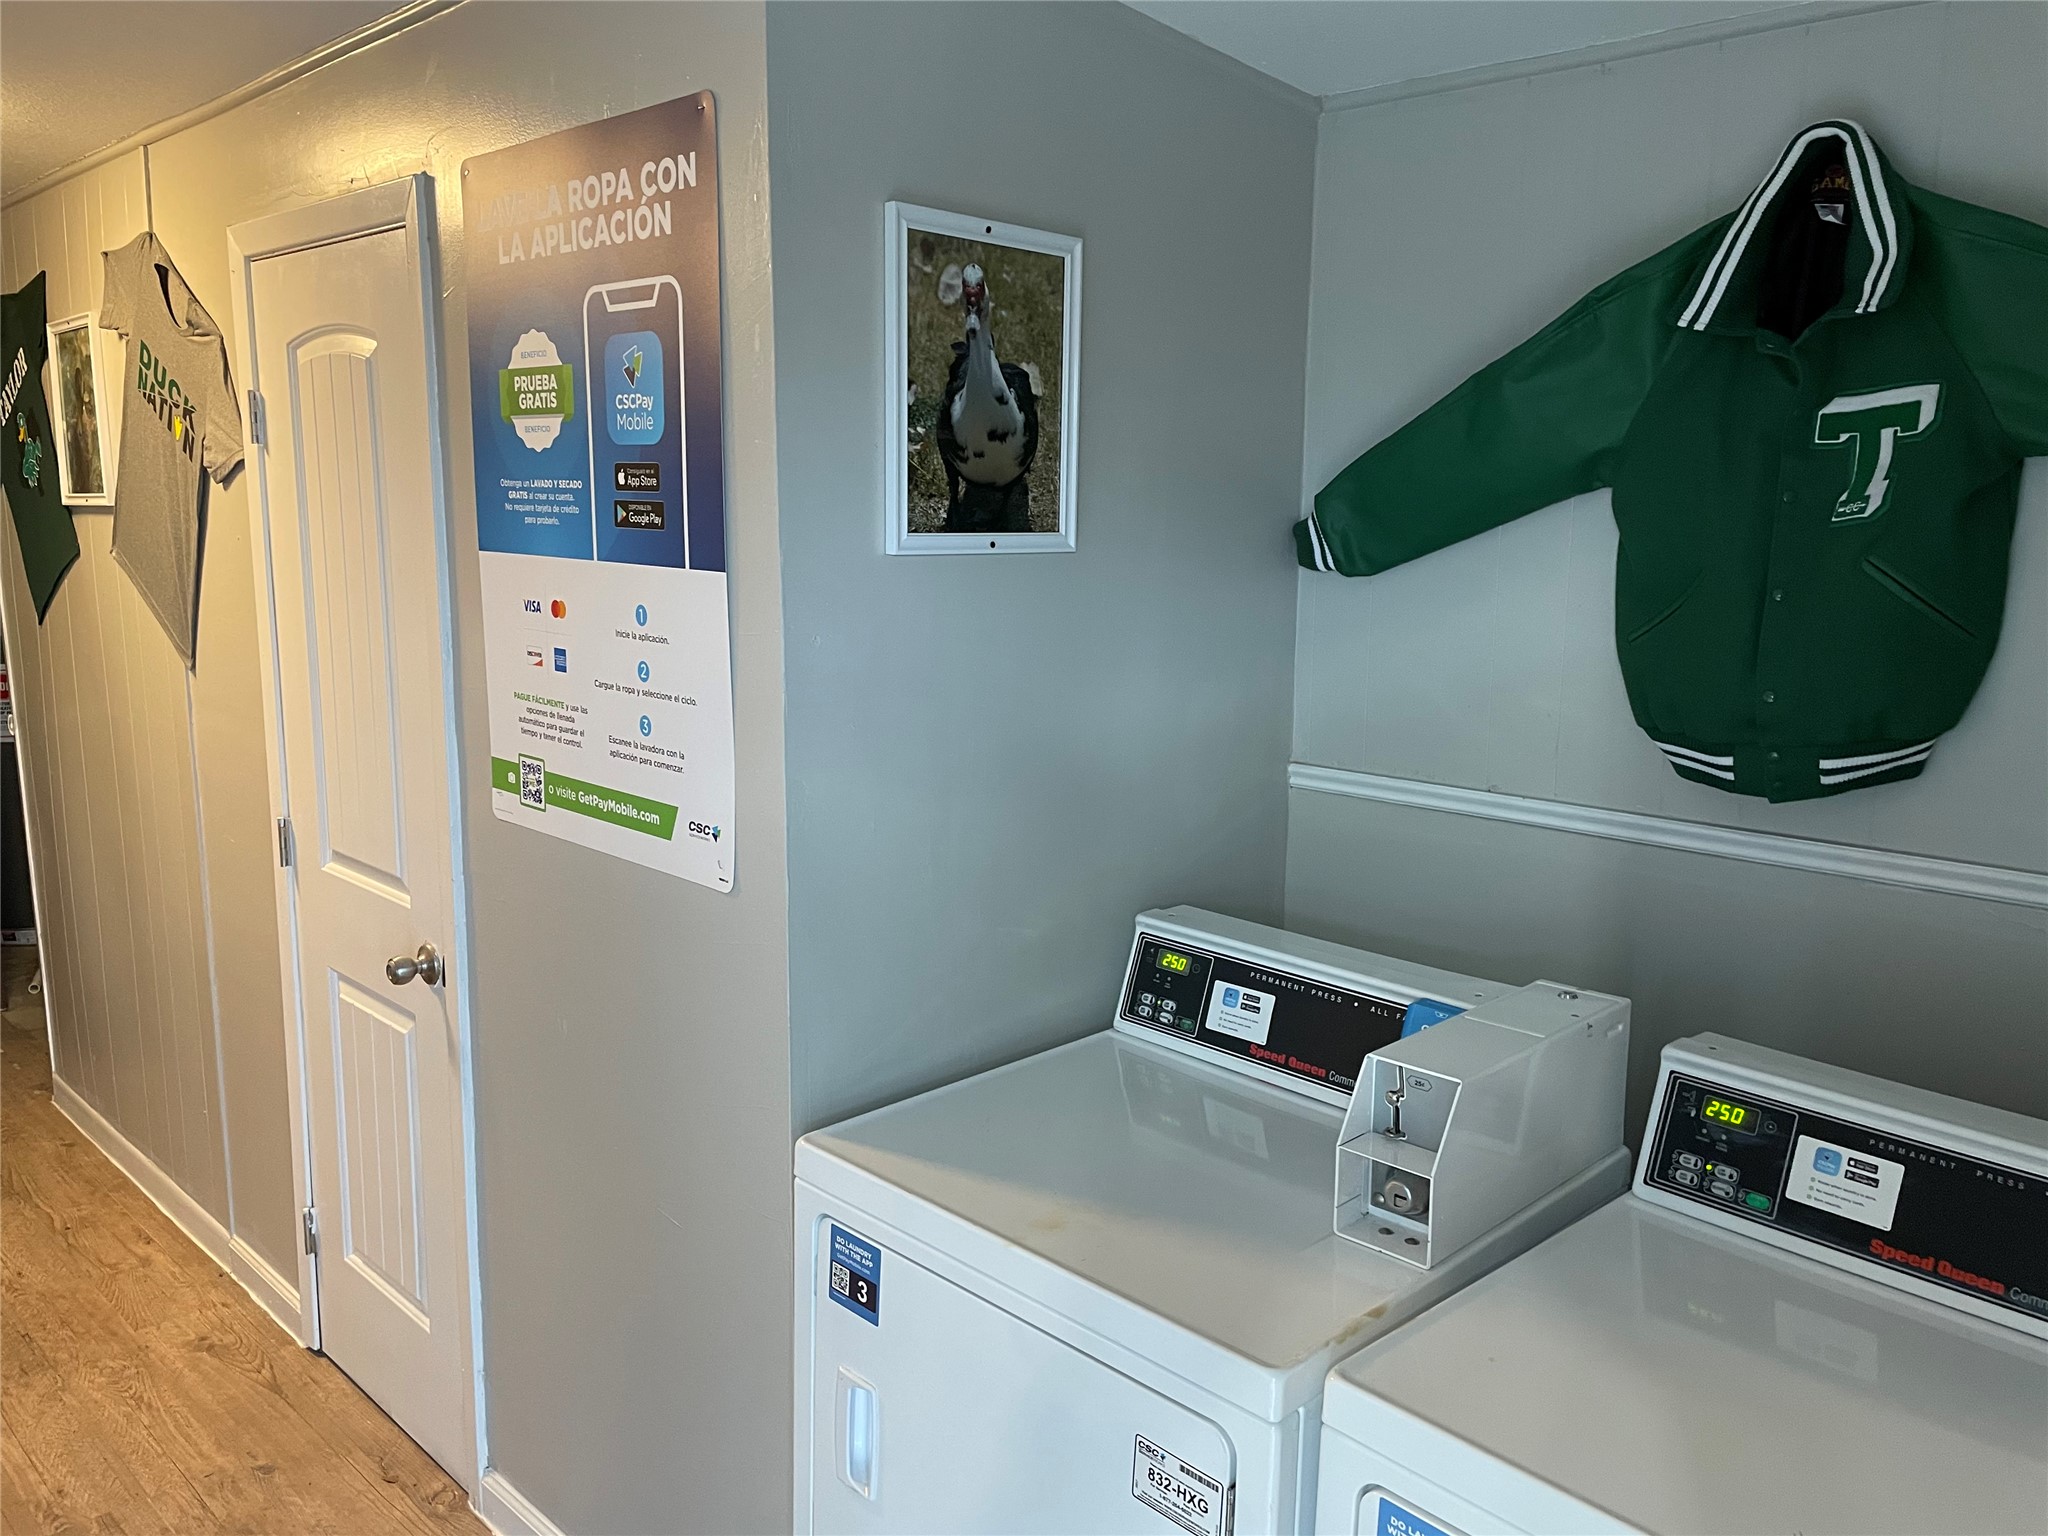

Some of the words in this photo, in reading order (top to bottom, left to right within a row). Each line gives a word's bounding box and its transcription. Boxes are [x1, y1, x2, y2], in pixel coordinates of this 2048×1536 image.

[534, 185, 562, 220] LA
[568, 167, 634, 213] ROPA
[640, 151, 697, 197] CON
[498, 231, 525, 265] LA
[530, 195, 671, 260] APLICACIÓN
[521, 350, 547, 359] BENEFICIO
[139, 339, 197, 435] DUCK
[514, 374, 558, 392] PRUEBA
[518, 392, 557, 409] GRATIS
[615, 393, 654, 411] CSCPay
[137, 364, 196, 463] NATIN
[616, 413, 654, 430] Mobile
[524, 425, 551, 433] BENEFICIO
[500, 478, 522, 488] Obtenga
[530, 479, 553, 488] LAVADO
[554, 480, 558, 488] Y
[559, 480, 583, 489] SECADO
[627, 475, 640, 488] App
[640, 475, 657, 486] Store
[508, 490, 528, 499] GRATIS
[529, 491, 534, 500] al
[505, 503, 513, 511] No
[514, 504, 534, 512] requiere
[535, 503, 552, 513] tarjeta
[553, 504, 560, 513] de
[560, 505, 580, 514] crédito
[524, 516, 536, 524] para
[629, 511, 649, 526] Google
[649, 513, 662, 526] Play
[523, 599, 541, 613] VISA
[615, 629, 630, 639] Inicie
[631, 630, 637, 640] la
[638, 633, 669, 644] aplicación.
[640, 663, 647, 678] 2
[594, 679, 614, 690] Cargue
[615, 683, 621, 691] la
[622, 686, 635, 695] ropa
[641, 689, 673, 701] seleccione
[673, 694, 679, 703] el
[681, 696, 698, 706] ciclo.
[513, 691, 531, 702] PAGUE
[532, 693, 565, 710] FÁCILMENTE
[570, 705, 579, 713] use
[580, 705, 588, 714] las
[526, 707, 548, 717] opciones
[549, 711, 556, 719] de
[518, 716, 545, 728] automático
[546, 722, 558, 731] para
[558, 725, 579, 736] guardar
[642, 718, 649, 734] 3
[520, 726, 538, 738] tiempo
[557, 735, 562, 743] el
[562, 738, 583, 748] control.
[608, 734, 632, 747] Escanee
[633, 740, 638, 749] la
[639, 741, 665, 755] lavadora
[665, 750, 677, 758] con
[678, 750, 685, 760] la
[609, 749, 638, 762] aplicación
[639, 757, 652, 766] para
[653, 760, 685, 774] comenzar.
[548, 785, 554, 794] o
[555, 786, 576, 801] visite
[578, 791, 660, 825] GetPayMobile.com
[688, 820, 711, 836] CSC
[1162, 953, 1187, 971] 250
[1250, 971, 1305, 992] PERMANENT
[1311, 989, 1342, 1003] PRESS
[1370, 1006, 1388, 1016] ALL
[1249, 1044, 1286, 1065] Speed
[1288, 1056, 1327, 1077] Queen
[1329, 1070, 1356, 1088] Comm
[1705, 1100, 1745, 1125] 250
[1869, 1138, 1956, 1170] PERMANENT
[1976, 1169, 2025, 1190] PRESS
[834, 1241, 850, 1256] WITH
[849, 1250, 862, 1262] THE
[861, 1257, 874, 1268] APP
[836, 1235, 845, 1245] DO
[845, 1240, 872, 1260] LAUNDRY
[1869, 1238, 1935, 1273] Speed
[1937, 1260, 2005, 1296] Queen
[856, 1280, 868, 1303] 3
[1138, 1440, 1160, 1457] CSC
[1147, 1467, 1209, 1514] 832-HXG
[1390, 1515, 1406, 1531] DO
